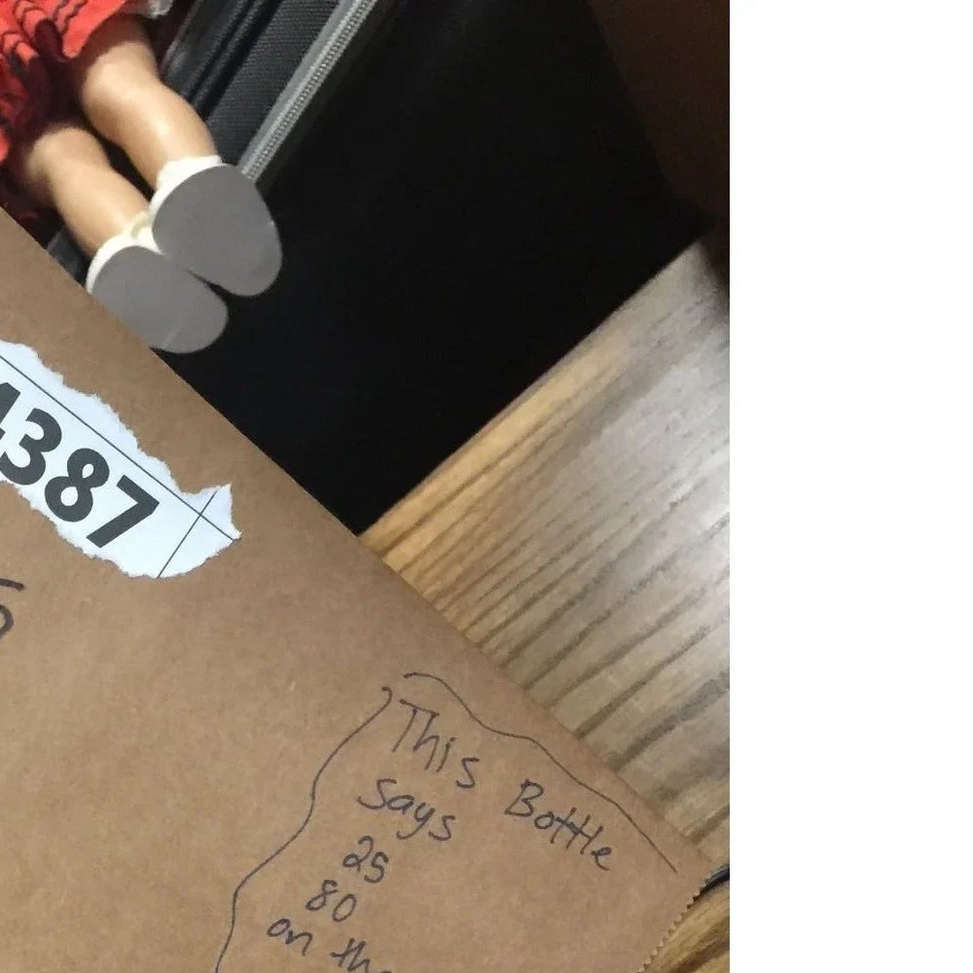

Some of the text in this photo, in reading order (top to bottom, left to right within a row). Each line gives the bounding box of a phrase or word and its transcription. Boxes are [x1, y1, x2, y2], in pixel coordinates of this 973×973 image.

[391, 699, 613, 871] This Bottle
[342, 836, 389, 883] 25
[305, 879, 358, 922] 80
[267, 918, 313, 955] on
